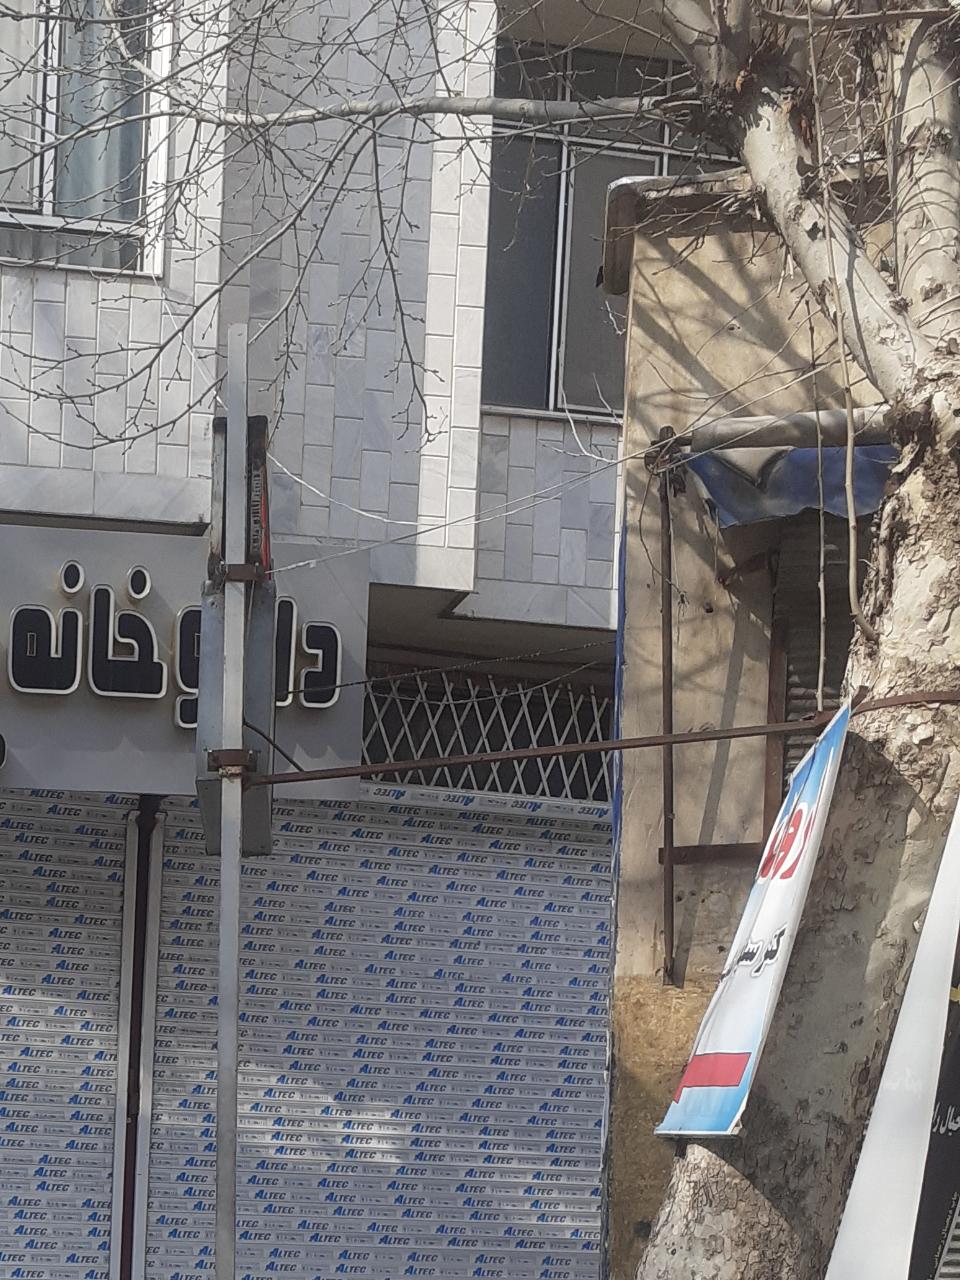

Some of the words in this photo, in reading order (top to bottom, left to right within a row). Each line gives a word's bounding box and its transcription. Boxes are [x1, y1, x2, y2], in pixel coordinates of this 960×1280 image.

[8, 560, 342, 729] داوخانه
[0, 817, 35, 830] ALTEC
[488, 840, 521, 852] ALTEC
[387, 847, 420, 859] ALTEC
[32, 866, 68, 879] ALTEC
[306, 870, 339, 882] ALTEC
[561, 875, 594, 887] ALTEC
[180, 891, 216, 904] ALTEC
[513, 886, 546, 898] ALTEC
[253, 911, 286, 923] ALTEC
[393, 906, 426, 918] ALTEC
[461, 911, 494, 924] ALTEC
[324, 915, 357, 928] ALTEC
[48, 927, 83, 940] ALTEC
[529, 930, 562, 942] ALTEC
[170, 935, 206, 948] ALTEC
[294, 958, 327, 971] ALTEC
[452, 954, 485, 966] ALTEC
[364, 963, 397, 975] ALTEC
[41, 973, 76, 986] ALTEC
[173, 979, 209, 992] ALTEC
[246, 984, 279, 996] ALTEC
[521, 986, 555, 999] ALTEC
[452, 997, 486, 1009] ALTEC
[5, 1016, 41, 1029] ALTEC
[80, 1021, 113, 1033] ALTEC
[355, 1034, 388, 1046] ALTEC
[424, 1038, 457, 1050] ALTEC
[558, 1045, 591, 1058] ALTEC
[6, 1061, 42, 1074] ALTEC
[80, 1065, 115, 1078] ALTEC
[289, 1060, 322, 1072] ALTEC
[495, 1070, 528, 1083] ALTEC
[346, 1077, 379, 1090] ALTEC
[415, 1080, 448, 1093] ALTEC
[178, 1098, 211, 1110] ALTEC
[250, 1101, 283, 1114] ALTEC
[458, 1111, 491, 1124] ALTEC
[526, 1114, 559, 1127] ALTEC
[64, 1138, 100, 1151] ALTEC
[340, 1134, 373, 1146] ALTEC
[409, 1137, 442, 1149] ALTEC
[176, 1171, 209, 1184] ALTEC
[247, 1174, 280, 1186] ALTEC
[463, 1168, 497, 1180] ALTEC
[531, 1171, 564, 1182] ALTEC
[386, 1179, 419, 1192] ALTEC
[7, 1194, 43, 1207] ALTEC
[324, 1191, 357, 1204] ALTEC
[156, 1214, 189, 1226] ALTEC
[297, 1218, 330, 1231] ALTEC
[535, 1212, 568, 1224] ALTEC
[366, 1221, 399, 1233] ALTEC
[435, 1223, 468, 1236] ALTEC
[338, 1248, 371, 1261] ALTEC
[10, 1266, 46, 1279] ALTEC
[265, 1260, 298, 1272] ALTEC
